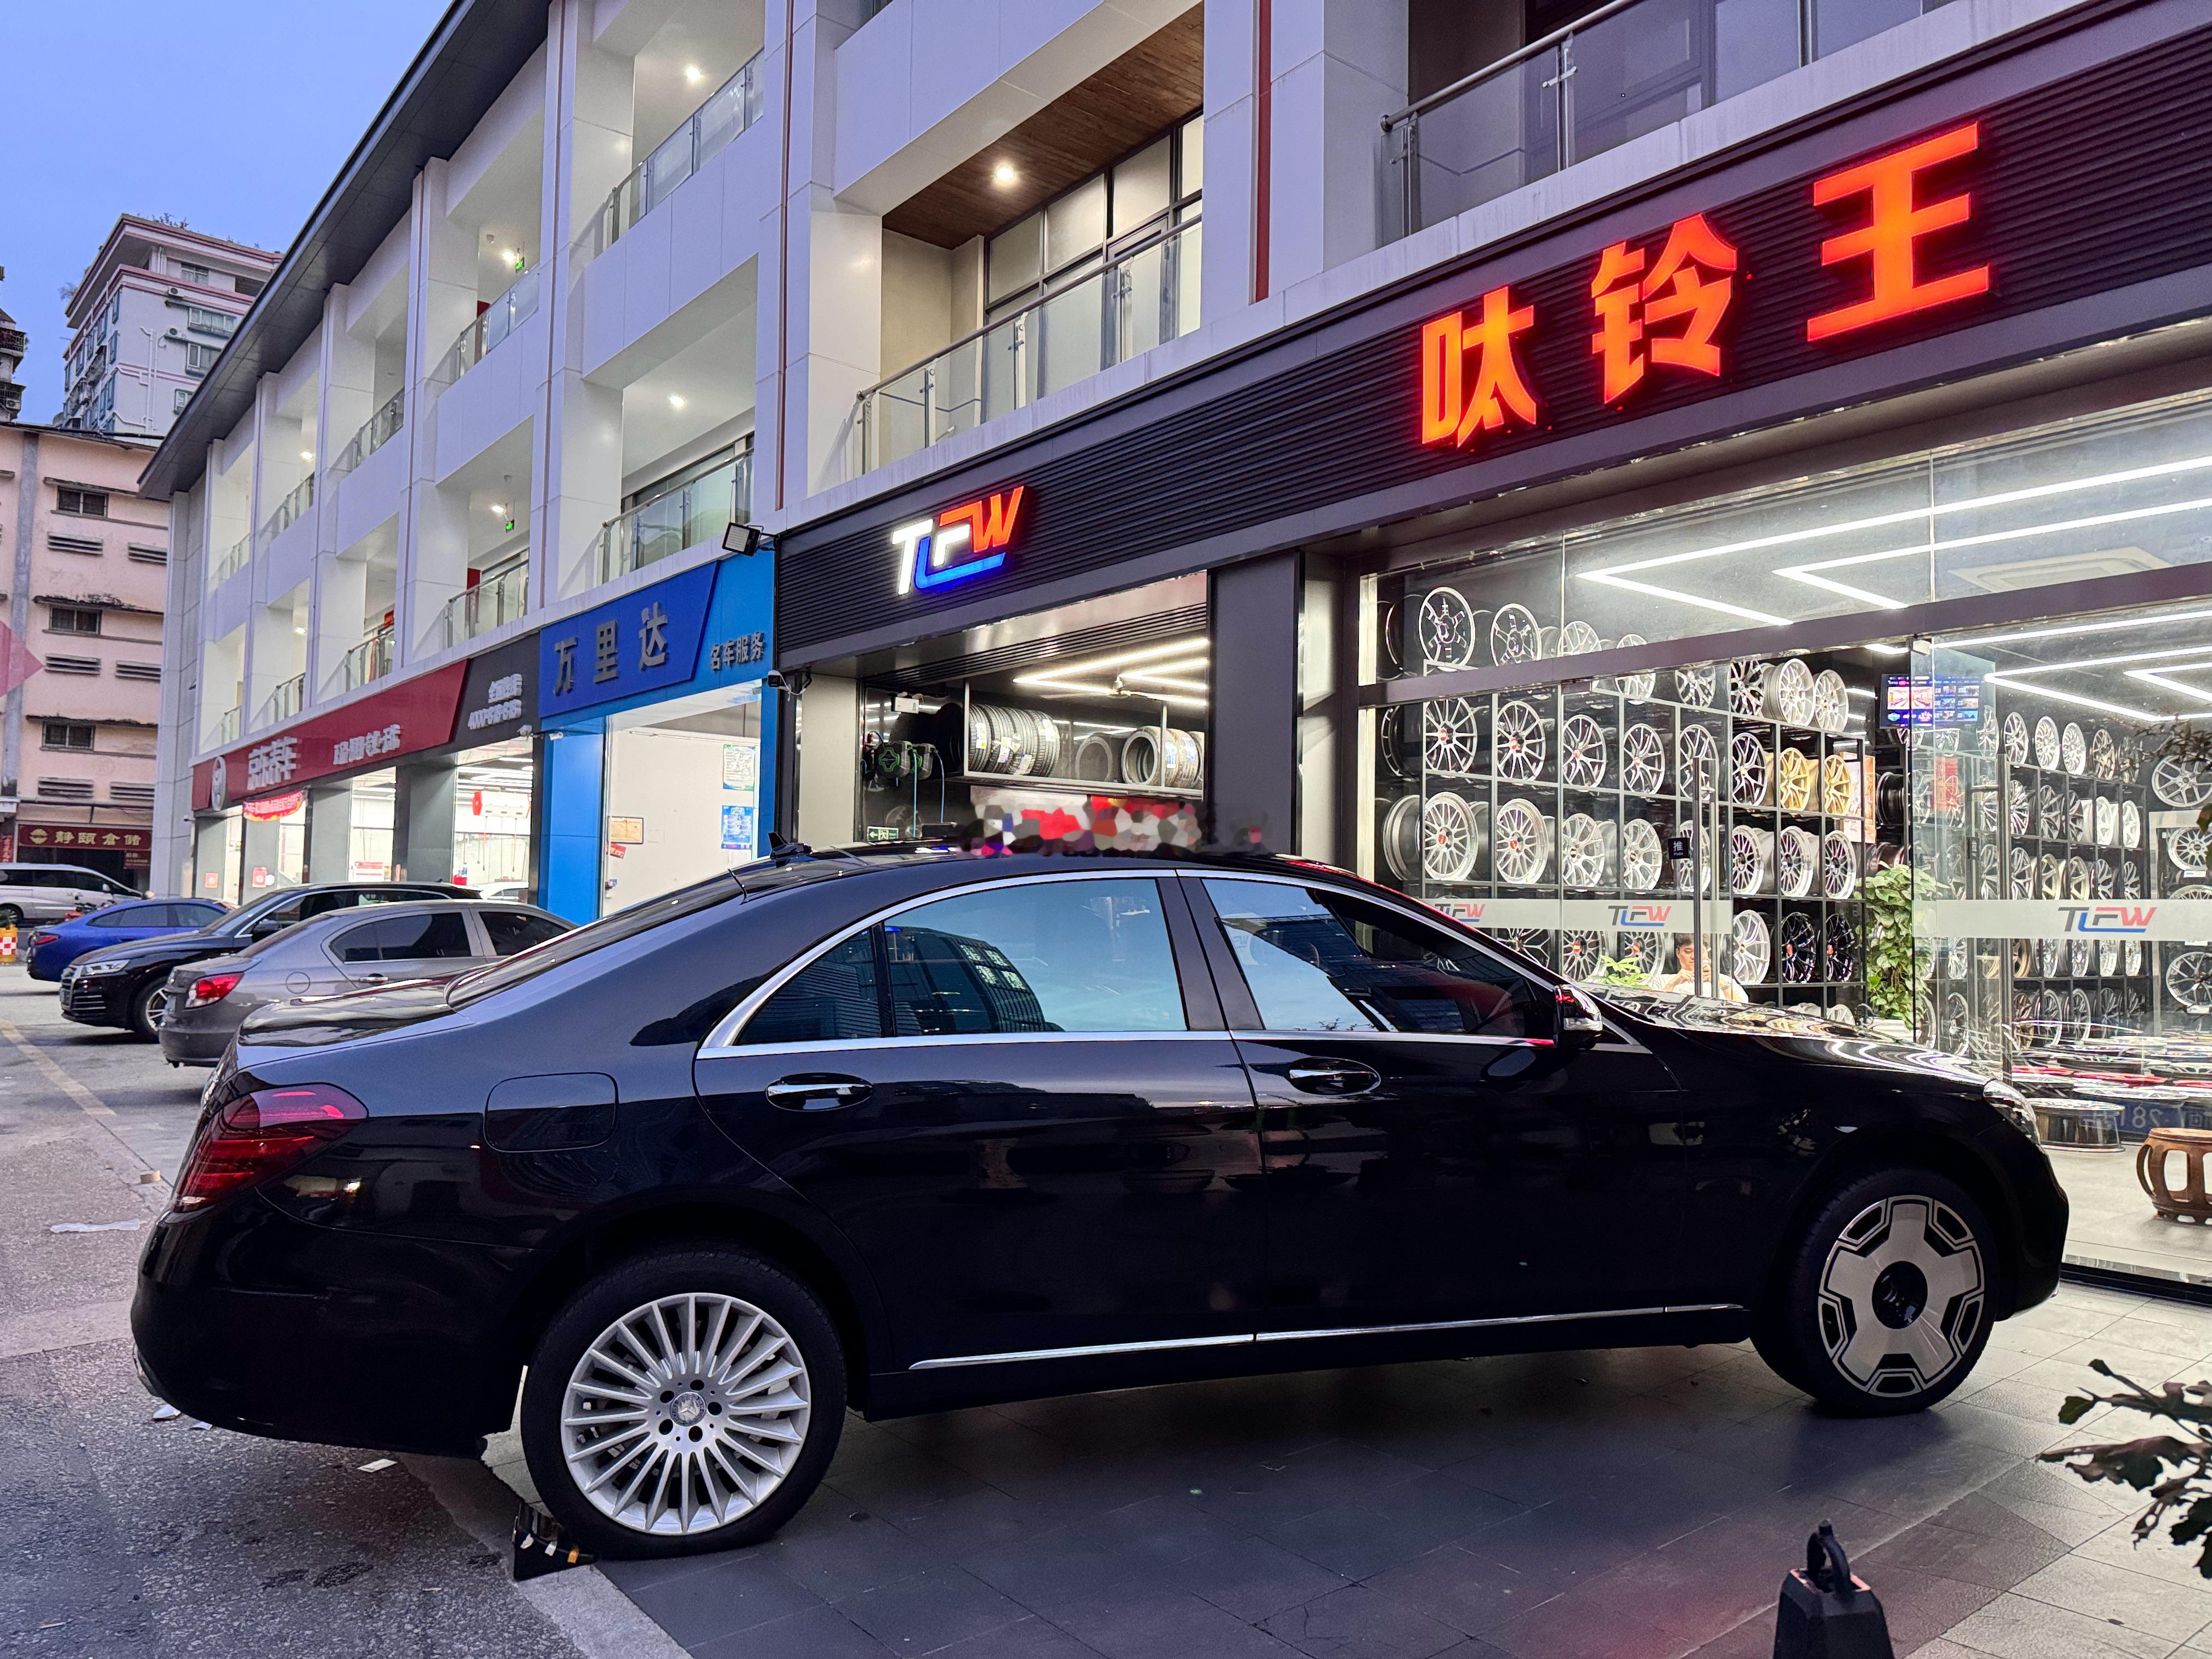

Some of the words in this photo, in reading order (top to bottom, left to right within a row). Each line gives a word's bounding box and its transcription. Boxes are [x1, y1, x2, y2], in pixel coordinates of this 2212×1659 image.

[1422, 122, 1990, 449] 呔铃王
[553, 602, 668, 696] 万里达
[710, 632, 764, 670] 名车服务
[1673, 840, 1684, 851] 推
